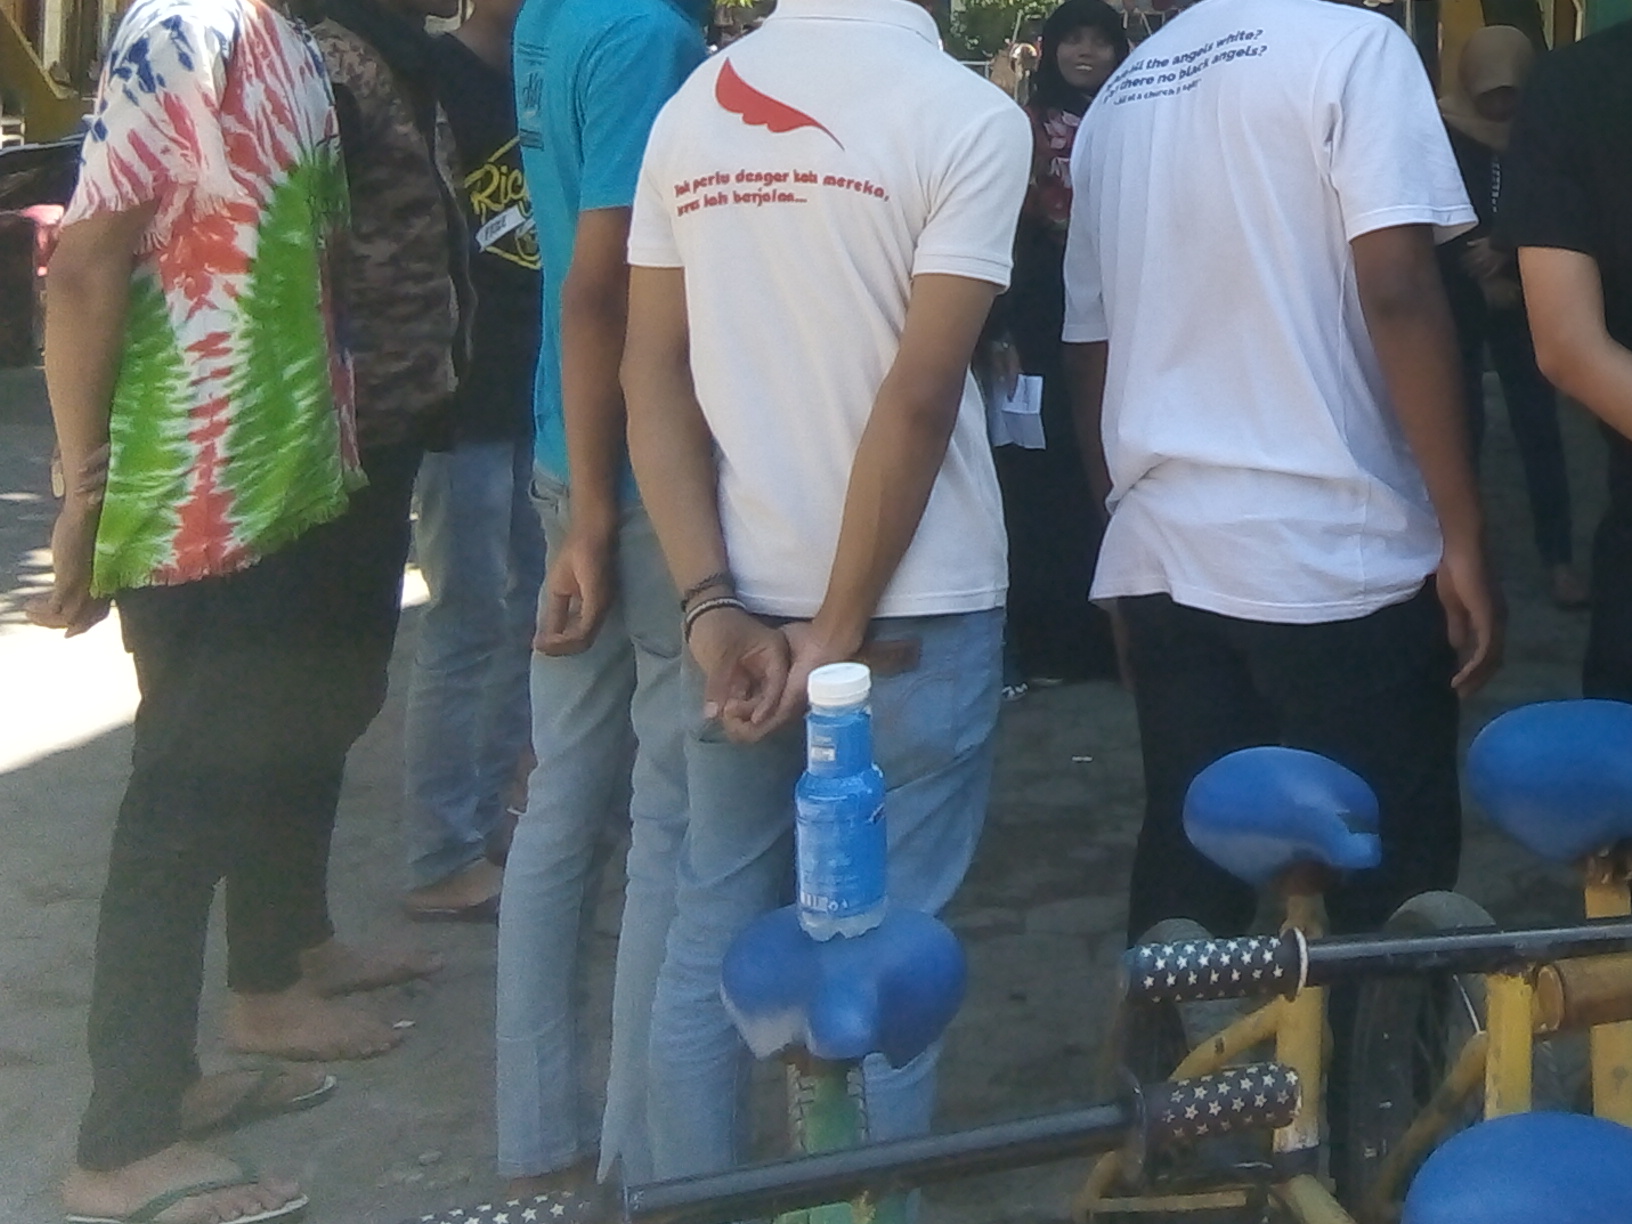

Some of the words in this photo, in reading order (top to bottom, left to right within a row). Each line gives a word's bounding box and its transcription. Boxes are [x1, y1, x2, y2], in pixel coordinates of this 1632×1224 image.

[1146, 58, 1170, 70] the
[1216, 29, 1264, 48] white?
[1157, 72, 1177, 84] no
[1178, 59, 1211, 80] black
[1211, 45, 1268, 64] angels?
[693, 171, 730, 193] perlu
